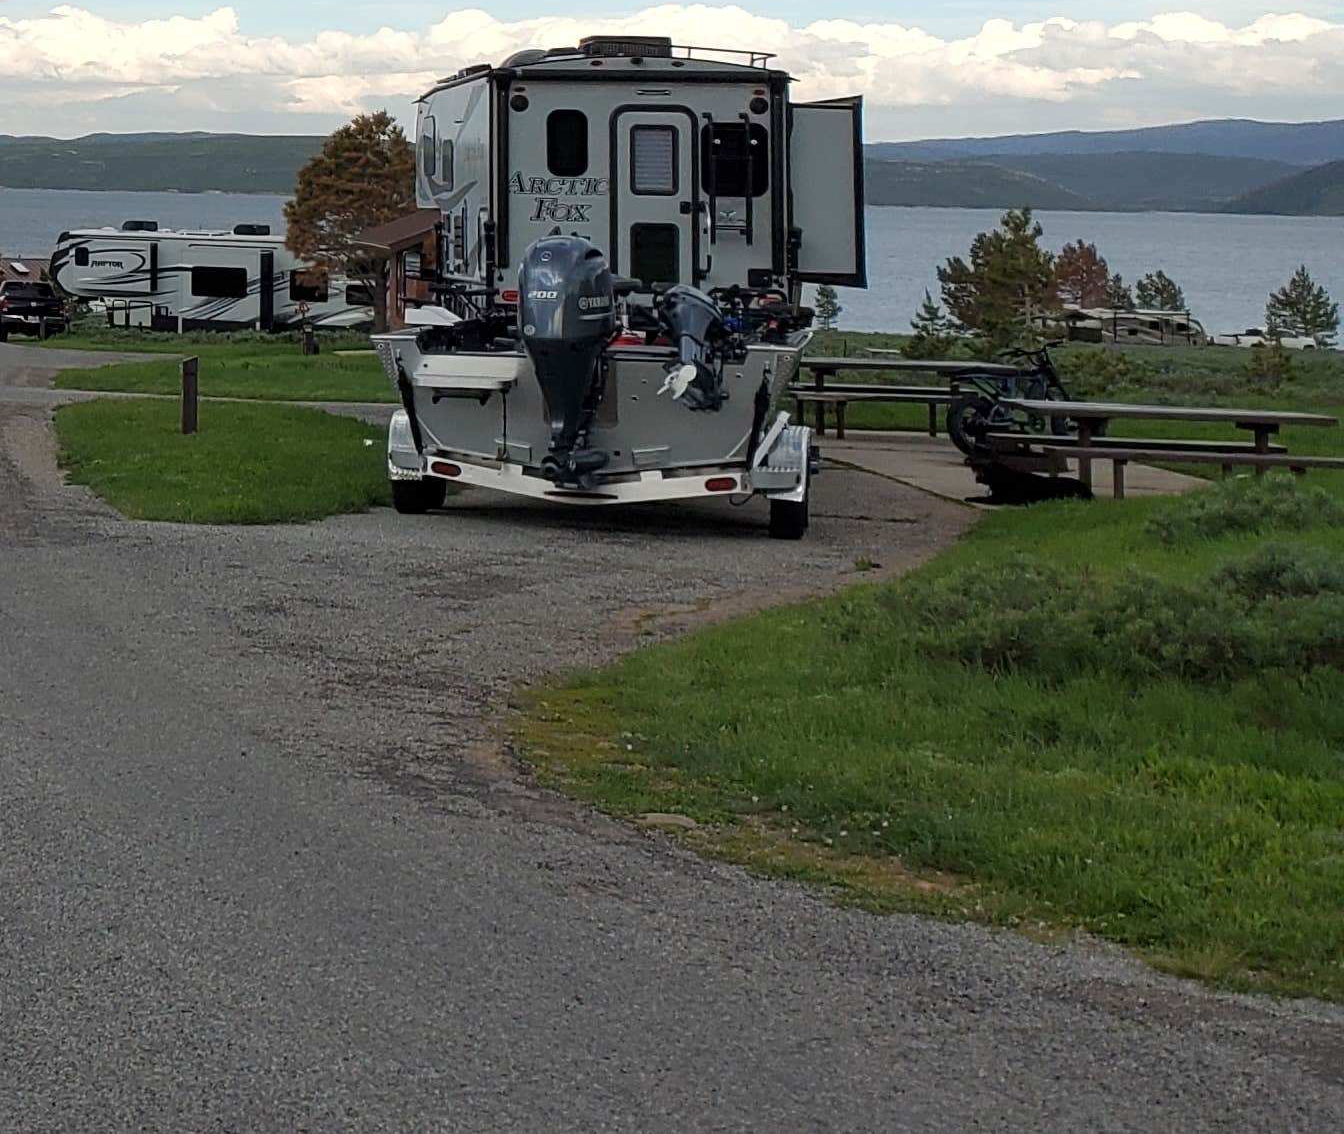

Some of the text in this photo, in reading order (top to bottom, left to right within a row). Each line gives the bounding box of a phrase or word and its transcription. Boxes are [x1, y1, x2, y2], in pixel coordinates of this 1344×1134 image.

[509, 170, 609, 196] ARCTIC
[529, 197, 592, 222] FOX
[90, 260, 124, 270] RAPTOR
[527, 290, 558, 300] 200
